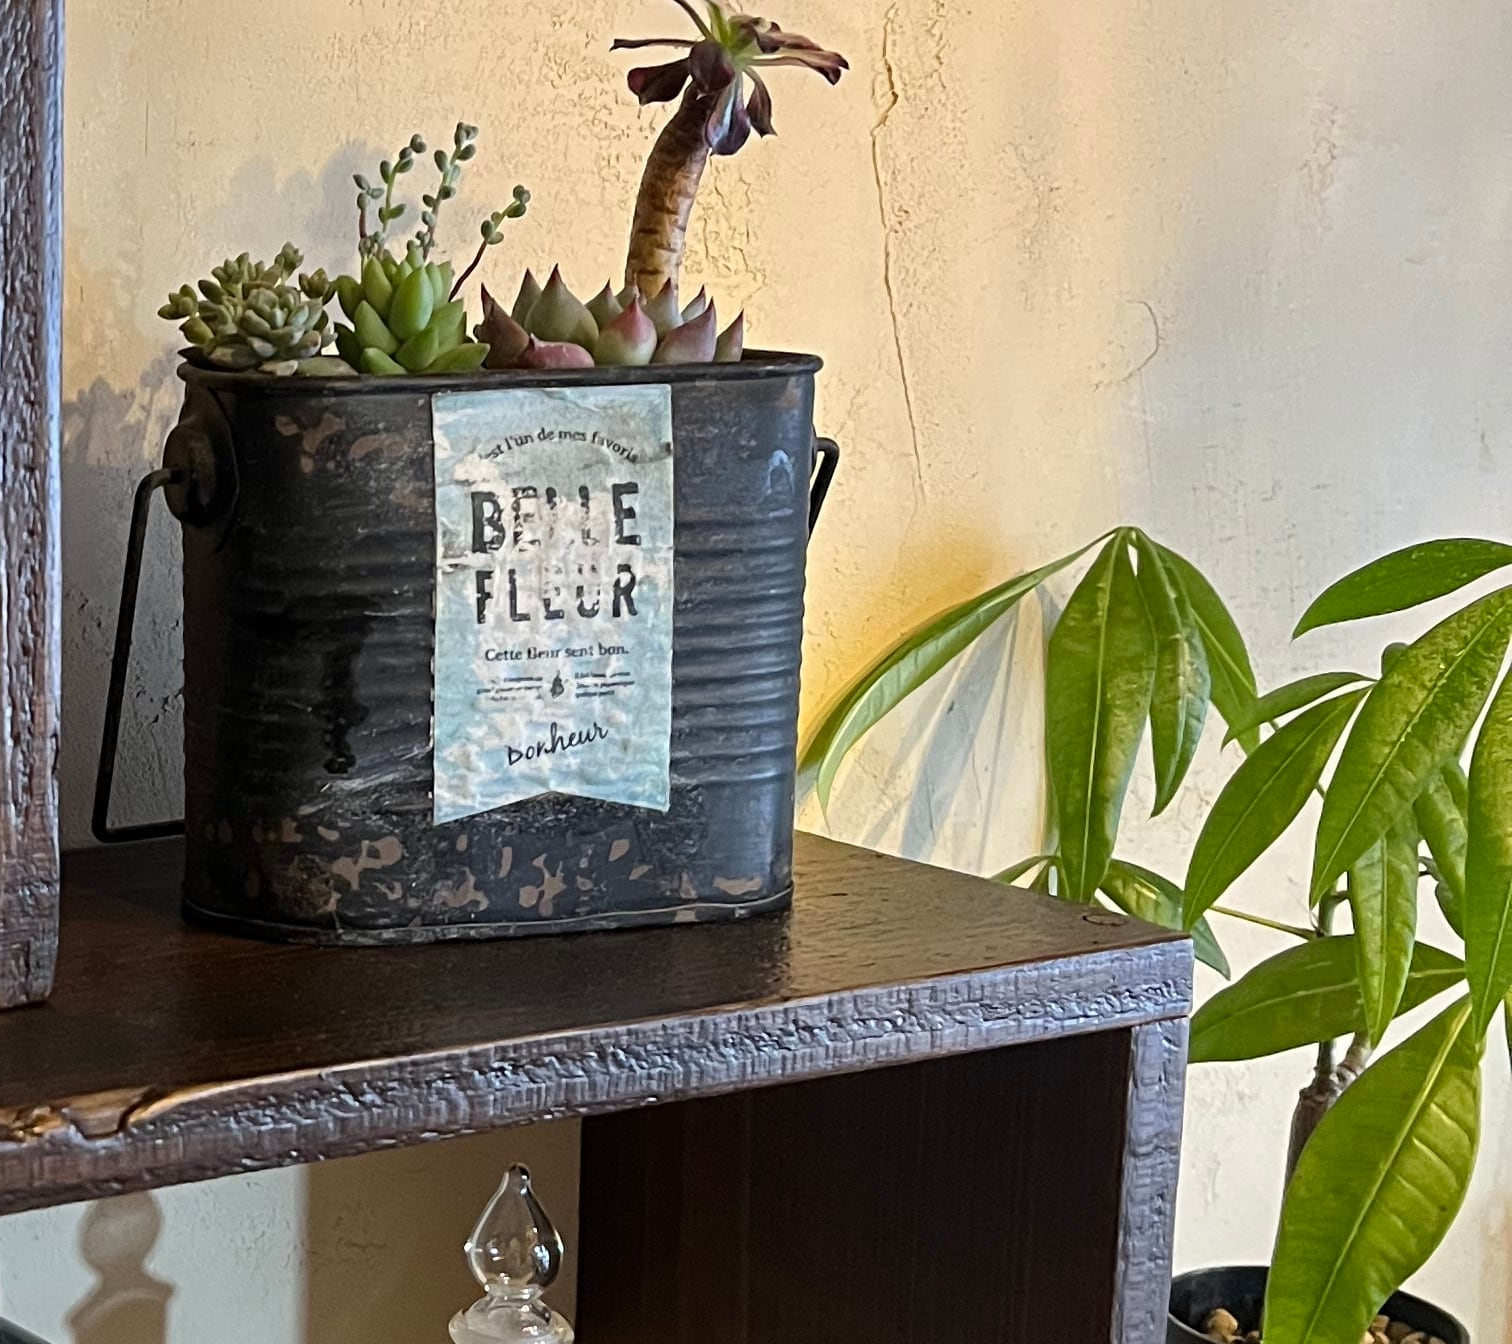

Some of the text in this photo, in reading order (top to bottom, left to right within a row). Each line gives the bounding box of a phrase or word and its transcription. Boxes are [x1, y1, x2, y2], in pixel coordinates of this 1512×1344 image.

[537, 426, 555, 442] de
[558, 430, 587, 442] mes
[484, 647, 523, 662] Cette
